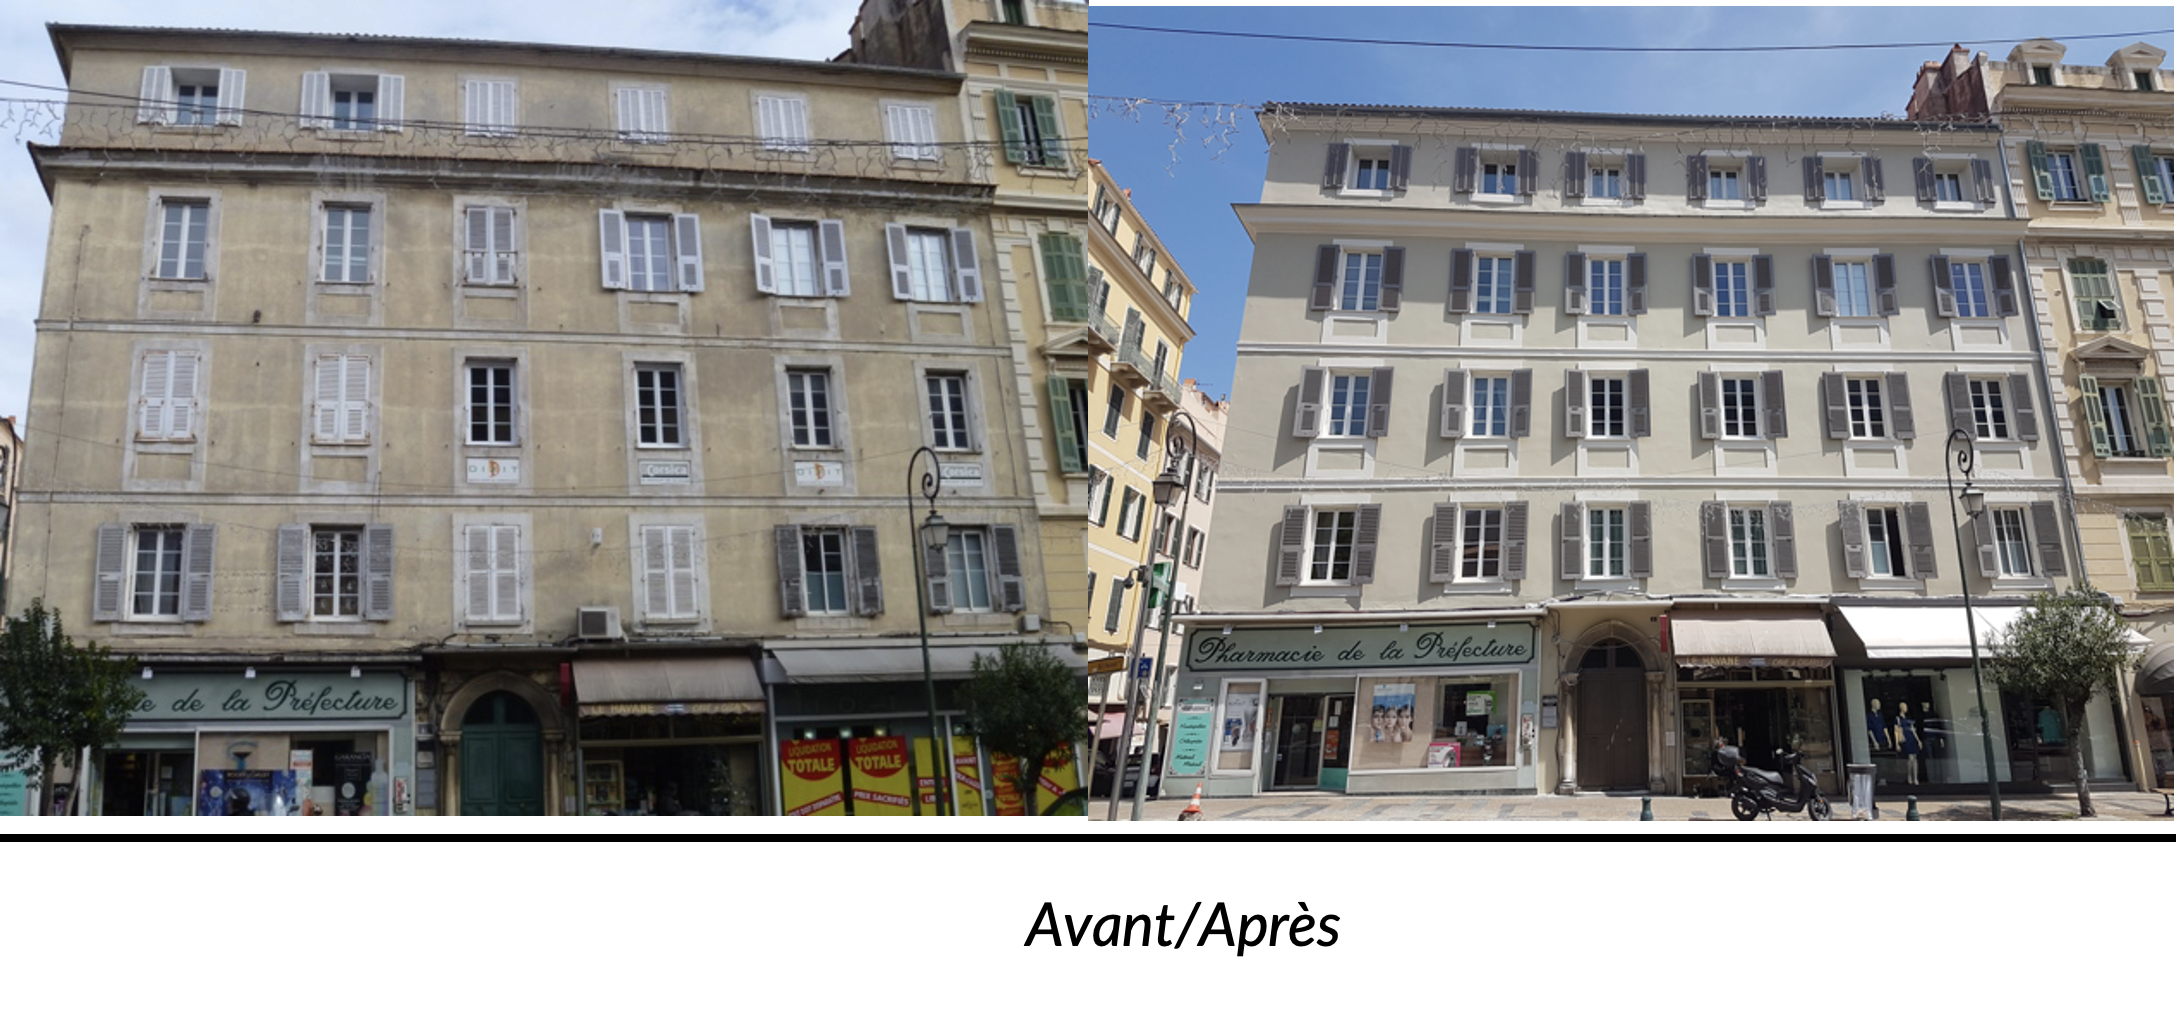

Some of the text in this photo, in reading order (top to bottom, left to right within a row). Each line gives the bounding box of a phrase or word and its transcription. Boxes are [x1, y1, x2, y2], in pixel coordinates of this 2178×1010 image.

[1194, 631, 1528, 663] Pharmacie de la Préfecture
[1686, 655, 1741, 666] LE HAVANE
[171, 689, 205, 712] de
[221, 689, 251, 712] la
[262, 679, 399, 716] Préfecture
[610, 704, 655, 715] HAVANE
[788, 742, 832, 757] LIQUIDATION
[856, 739, 898, 754] LIQUIDATION
[787, 757, 835, 774] TOTALE
[855, 754, 902, 771] TOTALE
